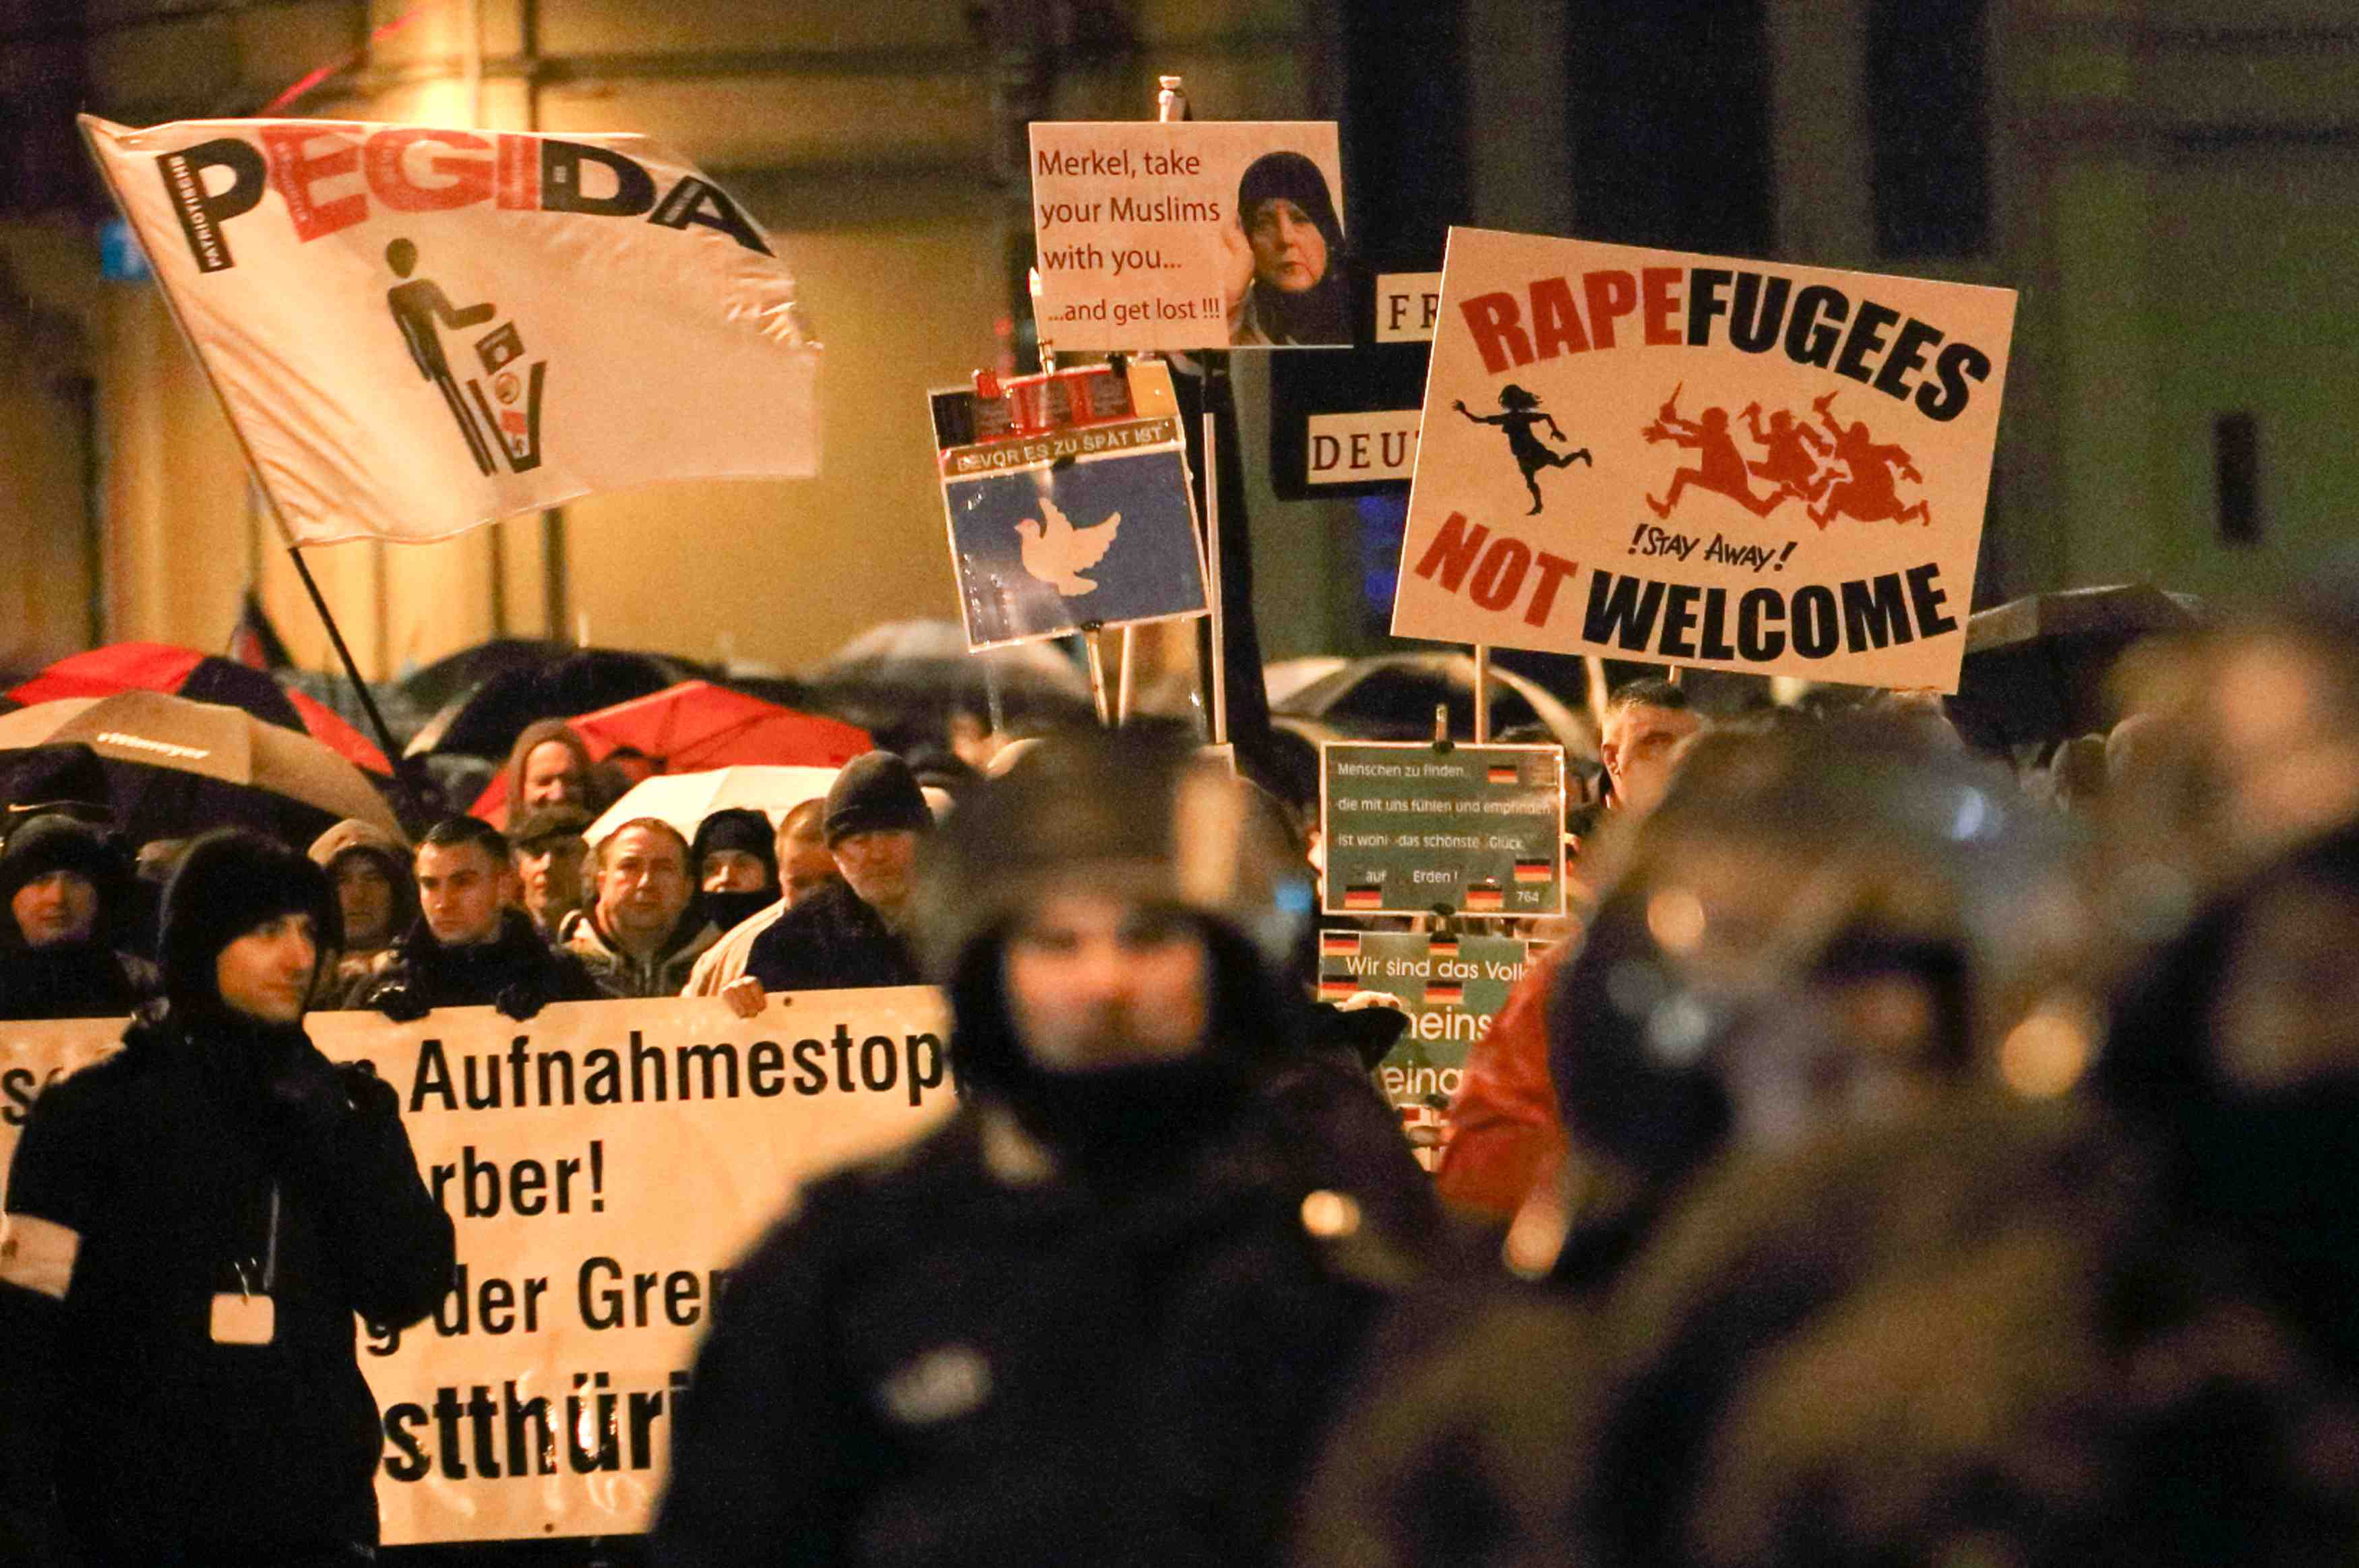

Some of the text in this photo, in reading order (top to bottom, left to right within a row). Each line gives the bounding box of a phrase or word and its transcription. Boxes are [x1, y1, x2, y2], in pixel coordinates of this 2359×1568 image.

[1038, 149, 1200, 179] Merkel, take
[155, 125, 777, 257] PEGIDA
[1040, 195, 1221, 230] your Muslims
[1043, 243, 1182, 276] with you...
[1047, 298, 1221, 325] ...and get lost !!!
[1459, 268, 1992, 422] RAPEFUGEES
[957, 449, 1020, 472] BEVOR
[1024, 443, 1049, 462] ES
[1053, 439, 1078, 459] ZU
[1135, 425, 1164, 445] IST
[1311, 431, 1419, 472] DEU
[1414, 510, 1958, 662] NOT WELCOME
[1337, 763, 1402, 777] Menschen
[1404, 766, 1419, 777] zu
[1338, 800, 1358, 812] die
[1361, 798, 1382, 811] mit
[1386, 800, 1409, 812] uns
[1455, 800, 1481, 813] und
[1338, 834, 1353, 846] ist
[1365, 870, 1386, 883] auf
[1413, 869, 1451, 883] Erden
[1345, 957, 1380, 976] Wir
[1385, 957, 1431, 978] sind
[1437, 959, 1479, 979] das
[431, 1262, 547, 1338] der
